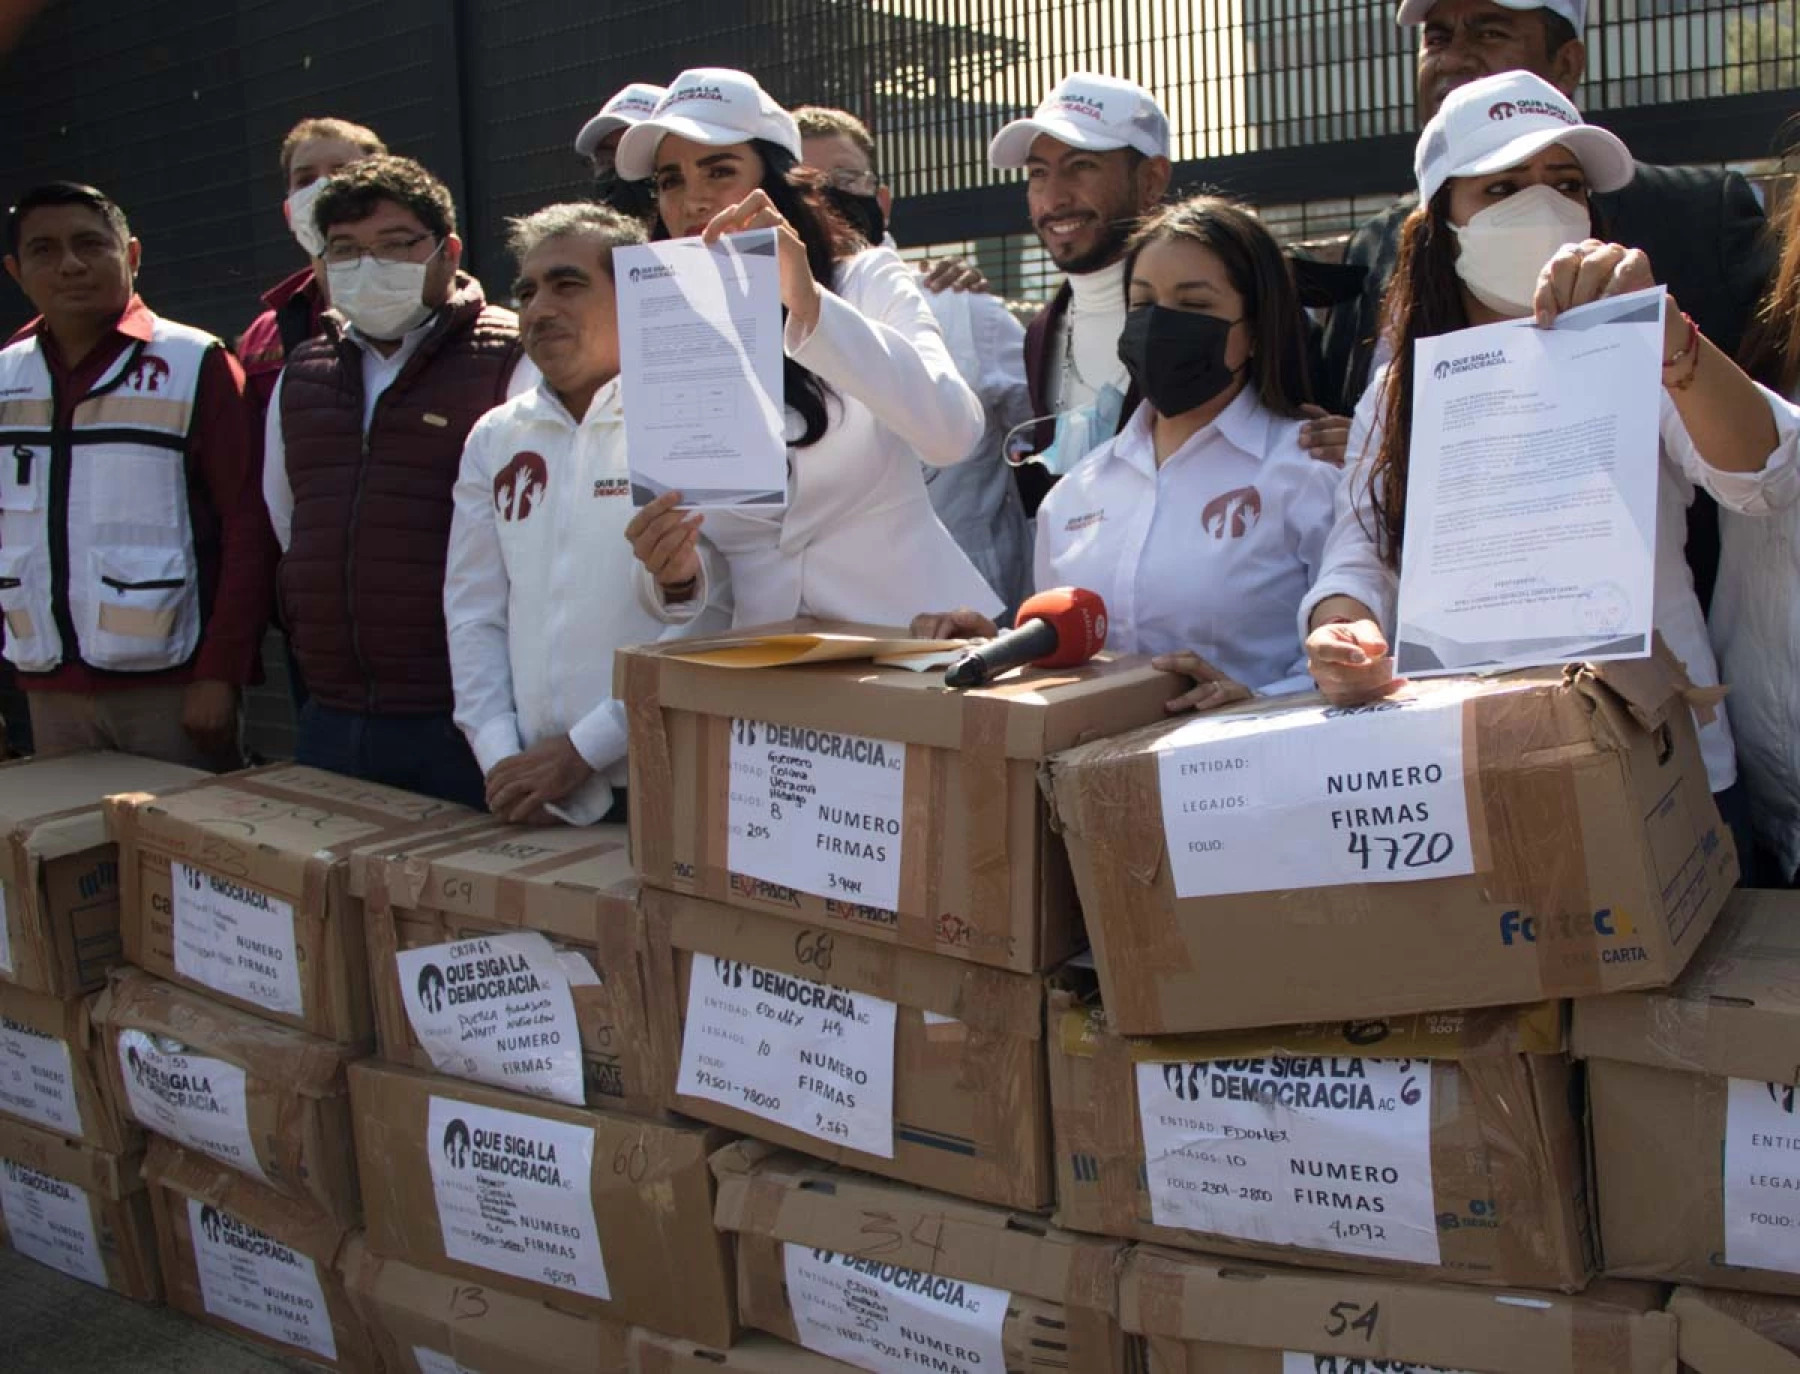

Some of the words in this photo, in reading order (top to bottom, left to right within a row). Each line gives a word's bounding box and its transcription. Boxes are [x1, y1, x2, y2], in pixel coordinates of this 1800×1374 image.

[764, 720, 887, 769] DEMOCRACIA
[1180, 756, 1250, 776] ENTIDAD:
[1326, 763, 1443, 795] NUMERO
[1182, 795, 1249, 814] LEGAJOS:
[1330, 801, 1430, 830] FIRMAS
[818, 804, 901, 837] NUMERO
[816, 834, 887, 863] FIRMAS
[1188, 839, 1225, 854] FOLIO:
[1346, 831, 1455, 871] 4720
[236, 935, 284, 961] NUMERO
[1601, 946, 1648, 964] CARTA
[237, 954, 279, 980] FIRMAS
[446, 960, 476, 984] QUE
[476, 954, 511, 980] SIGA
[510, 952, 531, 974] LA
[447, 973, 542, 1007] DEMOCRACIA
[751, 967, 856, 1022] DEMOCRACIA
[496, 1030, 562, 1054] NUMERO
[502, 1056, 554, 1077] FIRMAS
[798, 1047, 869, 1087] NUMERO
[1270, 1055, 1325, 1080] SIGA
[1330, 1057, 1366, 1080] LA
[190, 1075, 212, 1094] LA
[796, 1074, 858, 1109] FIRMAS
[1210, 1075, 1376, 1112] DEMOCRACIA
[1377, 1097, 1397, 1112] AC
[472, 1127, 503, 1151] QUE
[503, 1134, 536, 1158] SIGA
[537, 1140, 557, 1164] LA
[472, 1151, 562, 1188] DEMOCRACIA
[1226, 1153, 1247, 1169] 10
[1289, 1157, 1400, 1185] NUMERO
[1293, 1187, 1386, 1214] FIRMAS
[221, 1212, 244, 1235] QUE
[519, 1213, 582, 1241] NUMERO
[223, 1229, 296, 1265] DEMOCRACIA
[524, 1235, 578, 1261] FIRMAS
[841, 1253, 965, 1309] DEMOCRACIA
[262, 1286, 314, 1311] NUMERO
[447, 1285, 490, 1321] 13
[265, 1302, 310, 1327] FIRMAS
[899, 1324, 982, 1366] NUMERO
[903, 1346, 976, 1374] FIRMA
